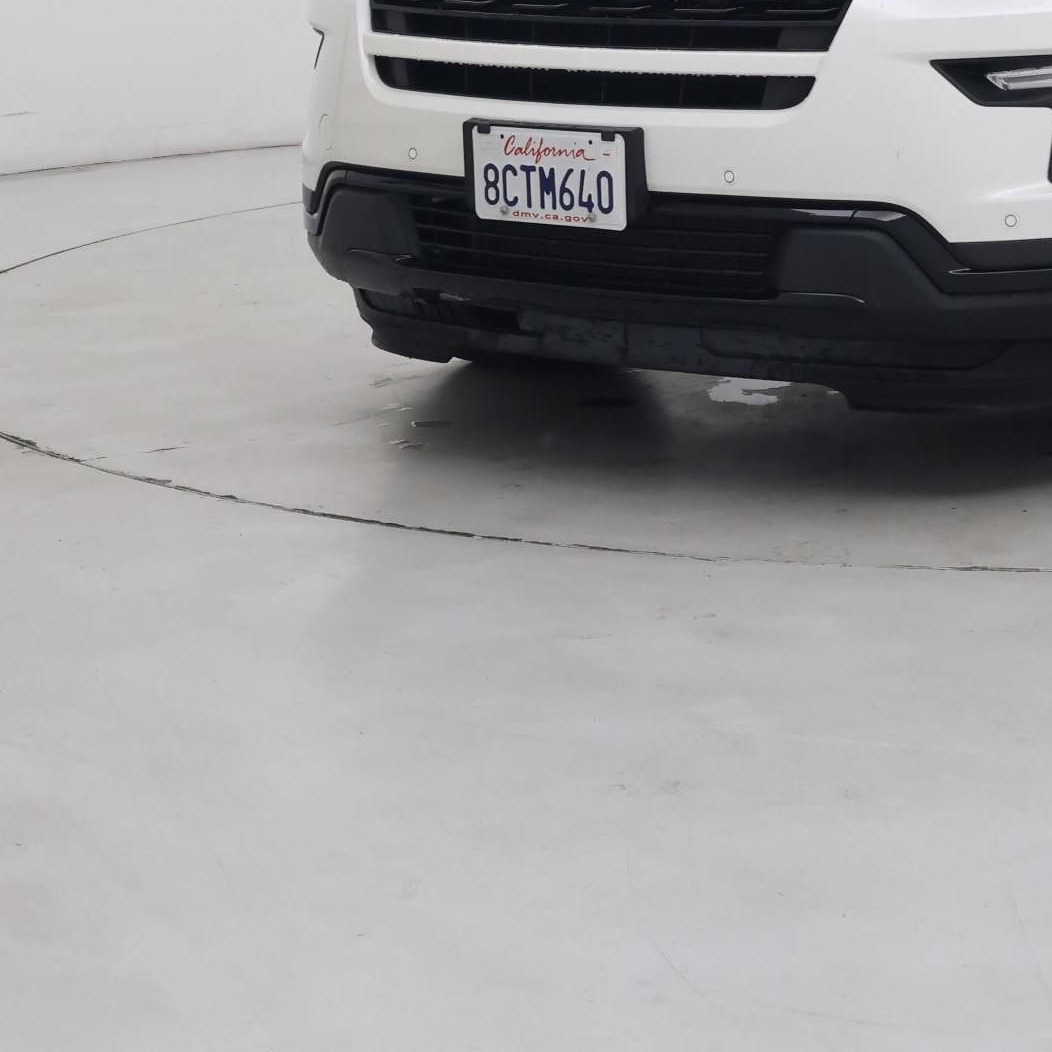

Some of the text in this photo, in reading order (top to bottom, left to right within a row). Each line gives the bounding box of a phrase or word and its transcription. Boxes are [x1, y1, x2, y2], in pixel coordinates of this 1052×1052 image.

[503, 134, 596, 164] California
[483, 162, 613, 215] 8CTM640
[512, 210, 589, 223] dmv.ca.gov
